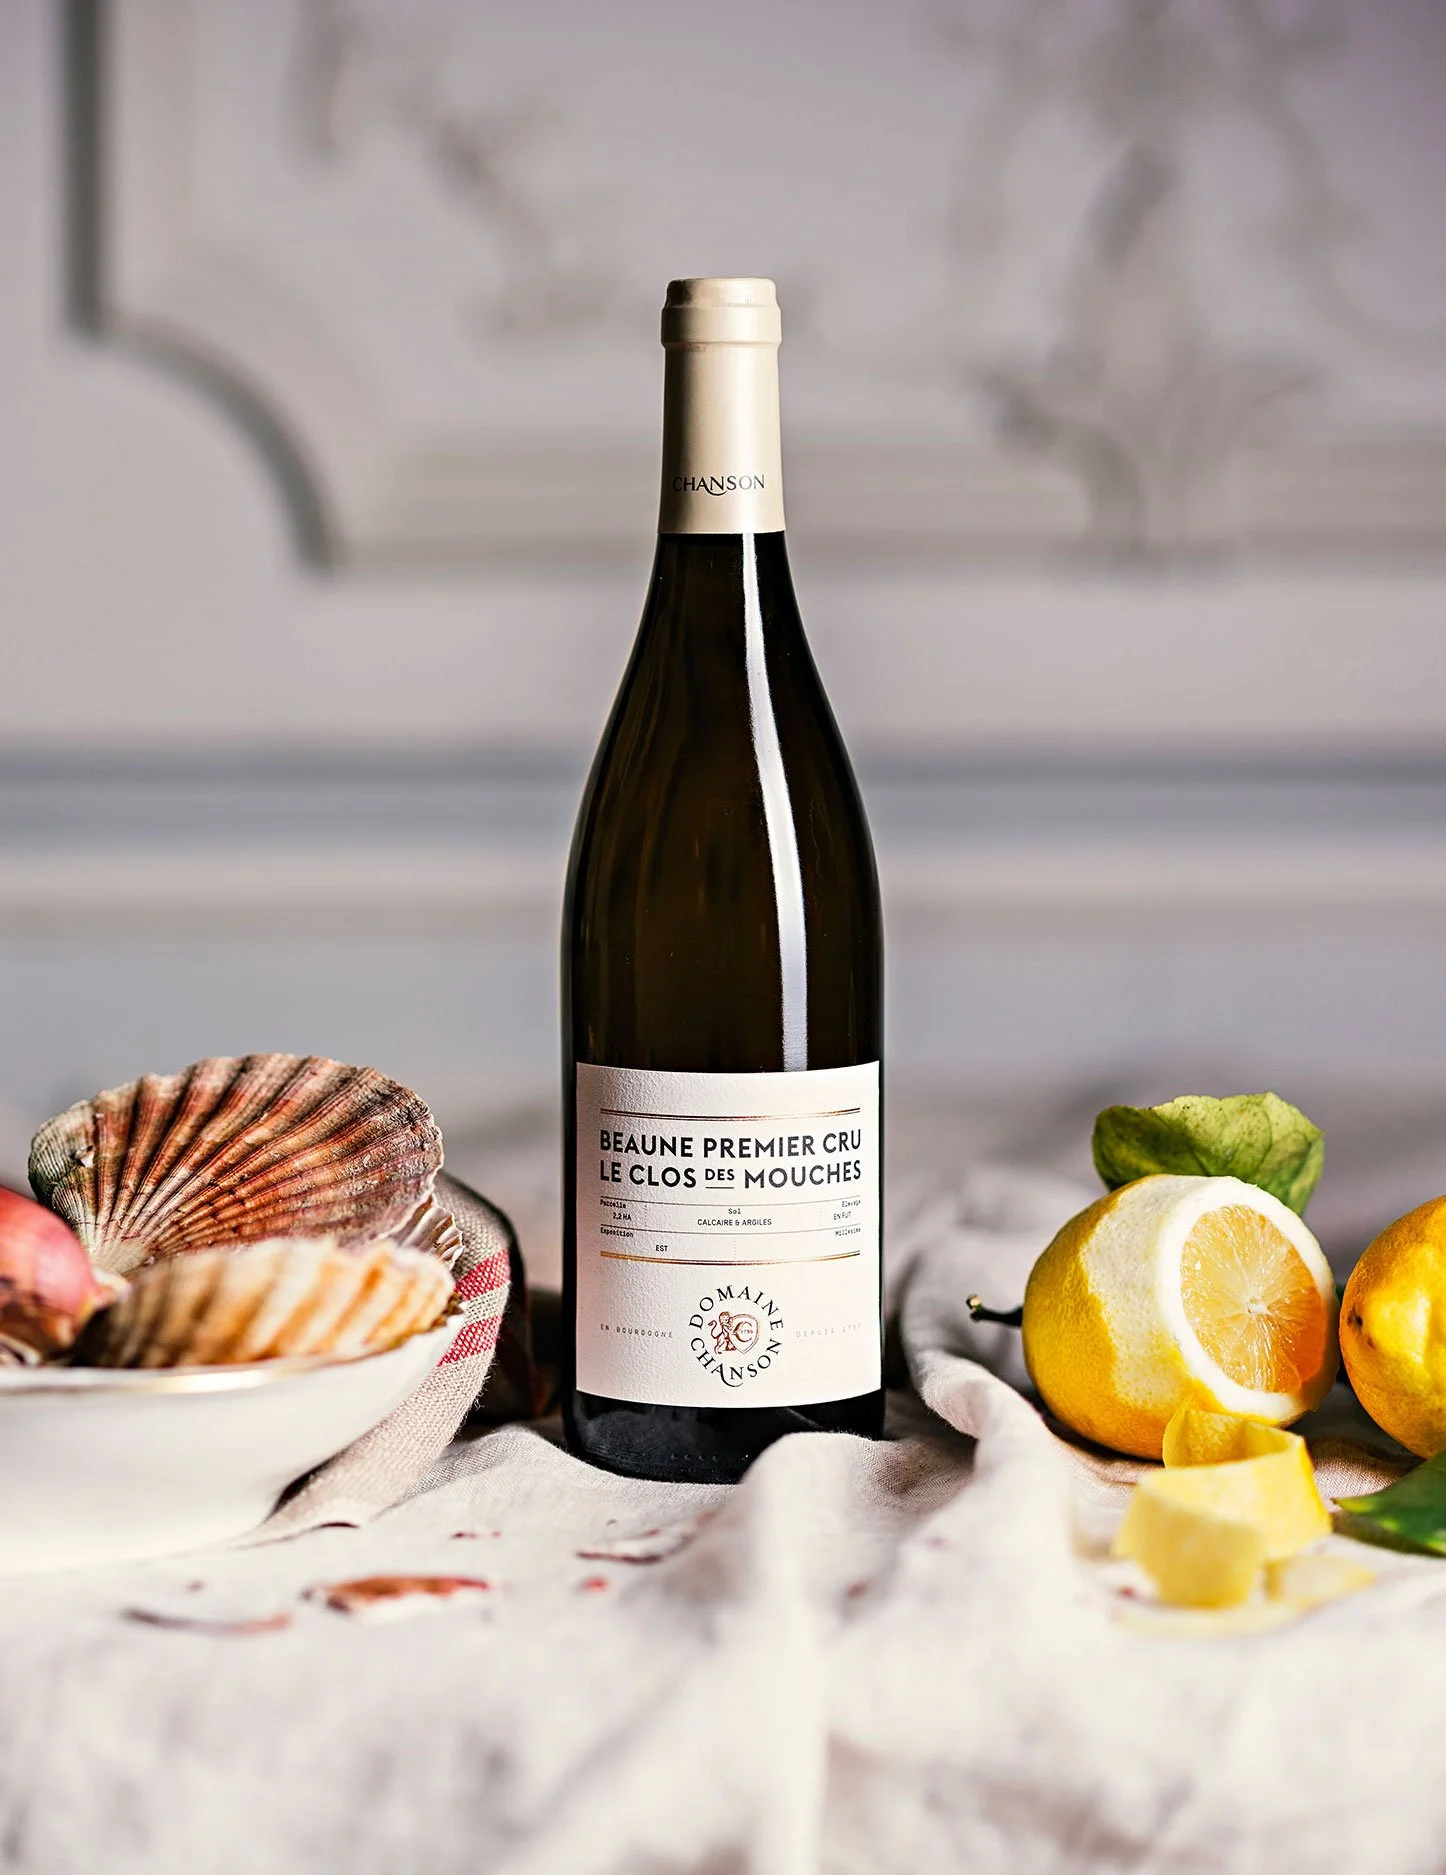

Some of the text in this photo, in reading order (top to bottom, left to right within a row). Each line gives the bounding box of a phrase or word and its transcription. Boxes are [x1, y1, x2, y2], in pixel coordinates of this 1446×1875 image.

[672, 474, 765, 496] CHANSON
[600, 1129, 861, 1158] BEAUNE PREMIER CRU
[600, 1160, 861, 1189] LE CLOS DES MOUCHES
[600, 1199, 627, 1209] Parcelle
[622, 1213, 632, 1221] HA
[742, 1218, 772, 1226] ARGILES
[600, 1227, 634, 1238] Exposition
[689, 1284, 784, 1331] DOMAINE
[616, 1326, 673, 1339] BOURGOGNE
[690, 1337, 783, 1388] CHANSON
